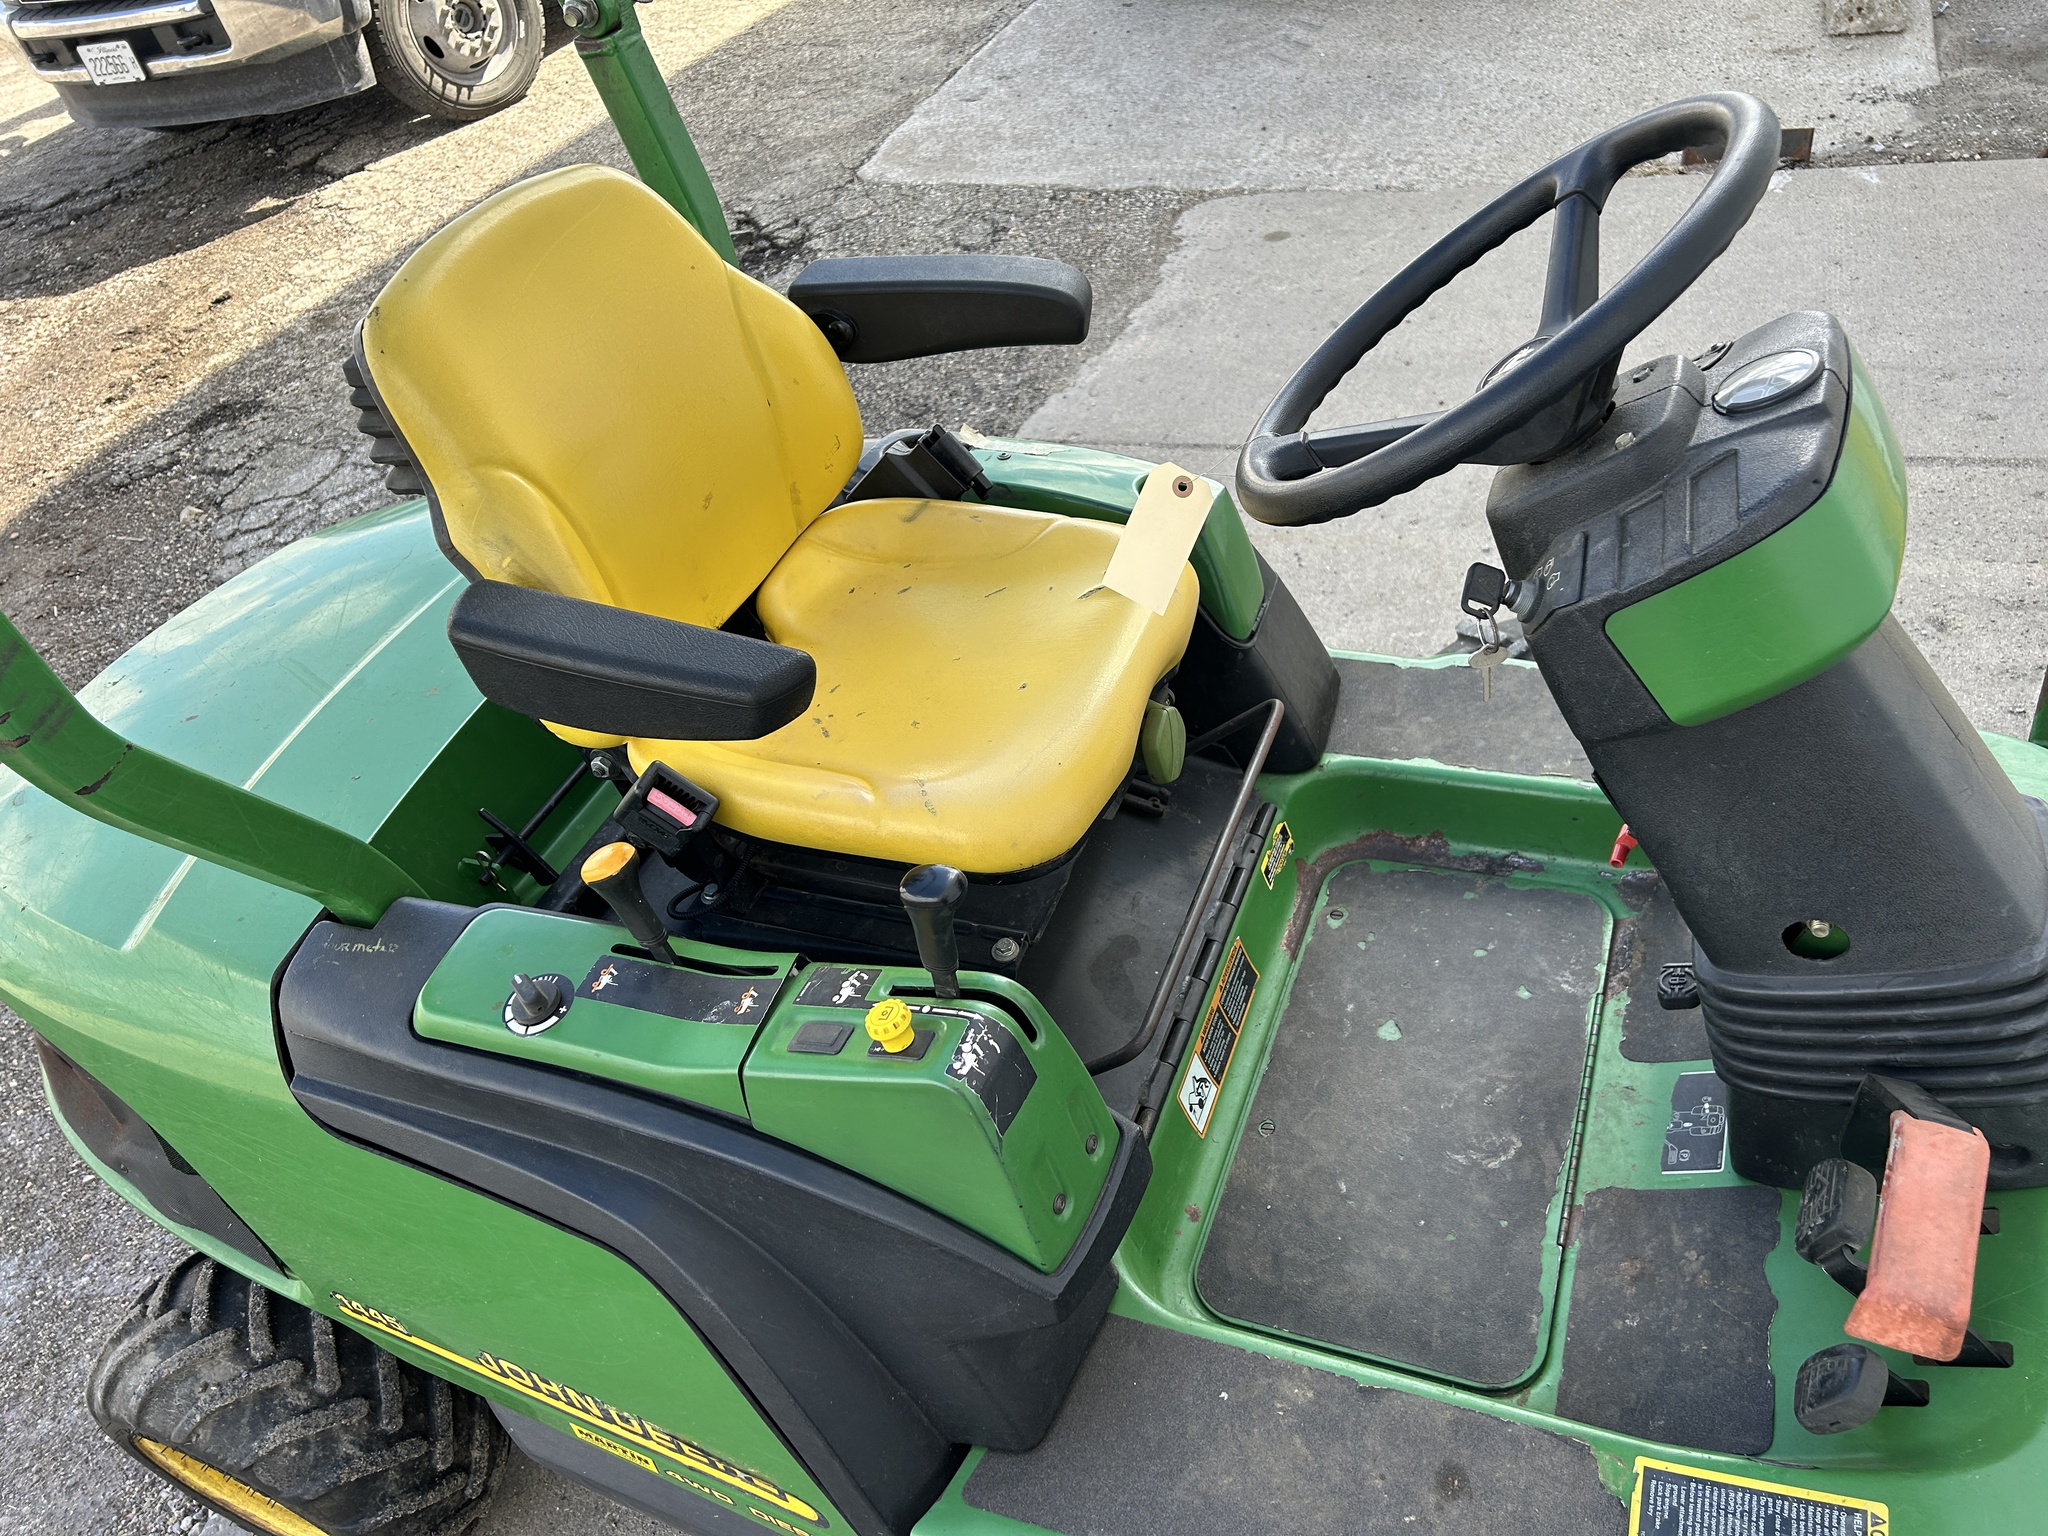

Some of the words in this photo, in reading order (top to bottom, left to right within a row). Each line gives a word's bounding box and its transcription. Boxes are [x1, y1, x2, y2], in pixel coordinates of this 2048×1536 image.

[88, 54, 130, 77] 222566
[1202, 1006, 1215, 1036] WARNING
[332, 1292, 409, 1335] 1445
[477, 1351, 604, 1417] JOHN
[577, 1428, 650, 1465] MARTIN
[664, 1470, 737, 1506] 4WD
[1649, 1480, 1657, 1504] Remove
[1760, 1497, 1766, 1505] Do
[1774, 1500, 1782, 1513] Stay
[1790, 1502, 1798, 1519] Keep
